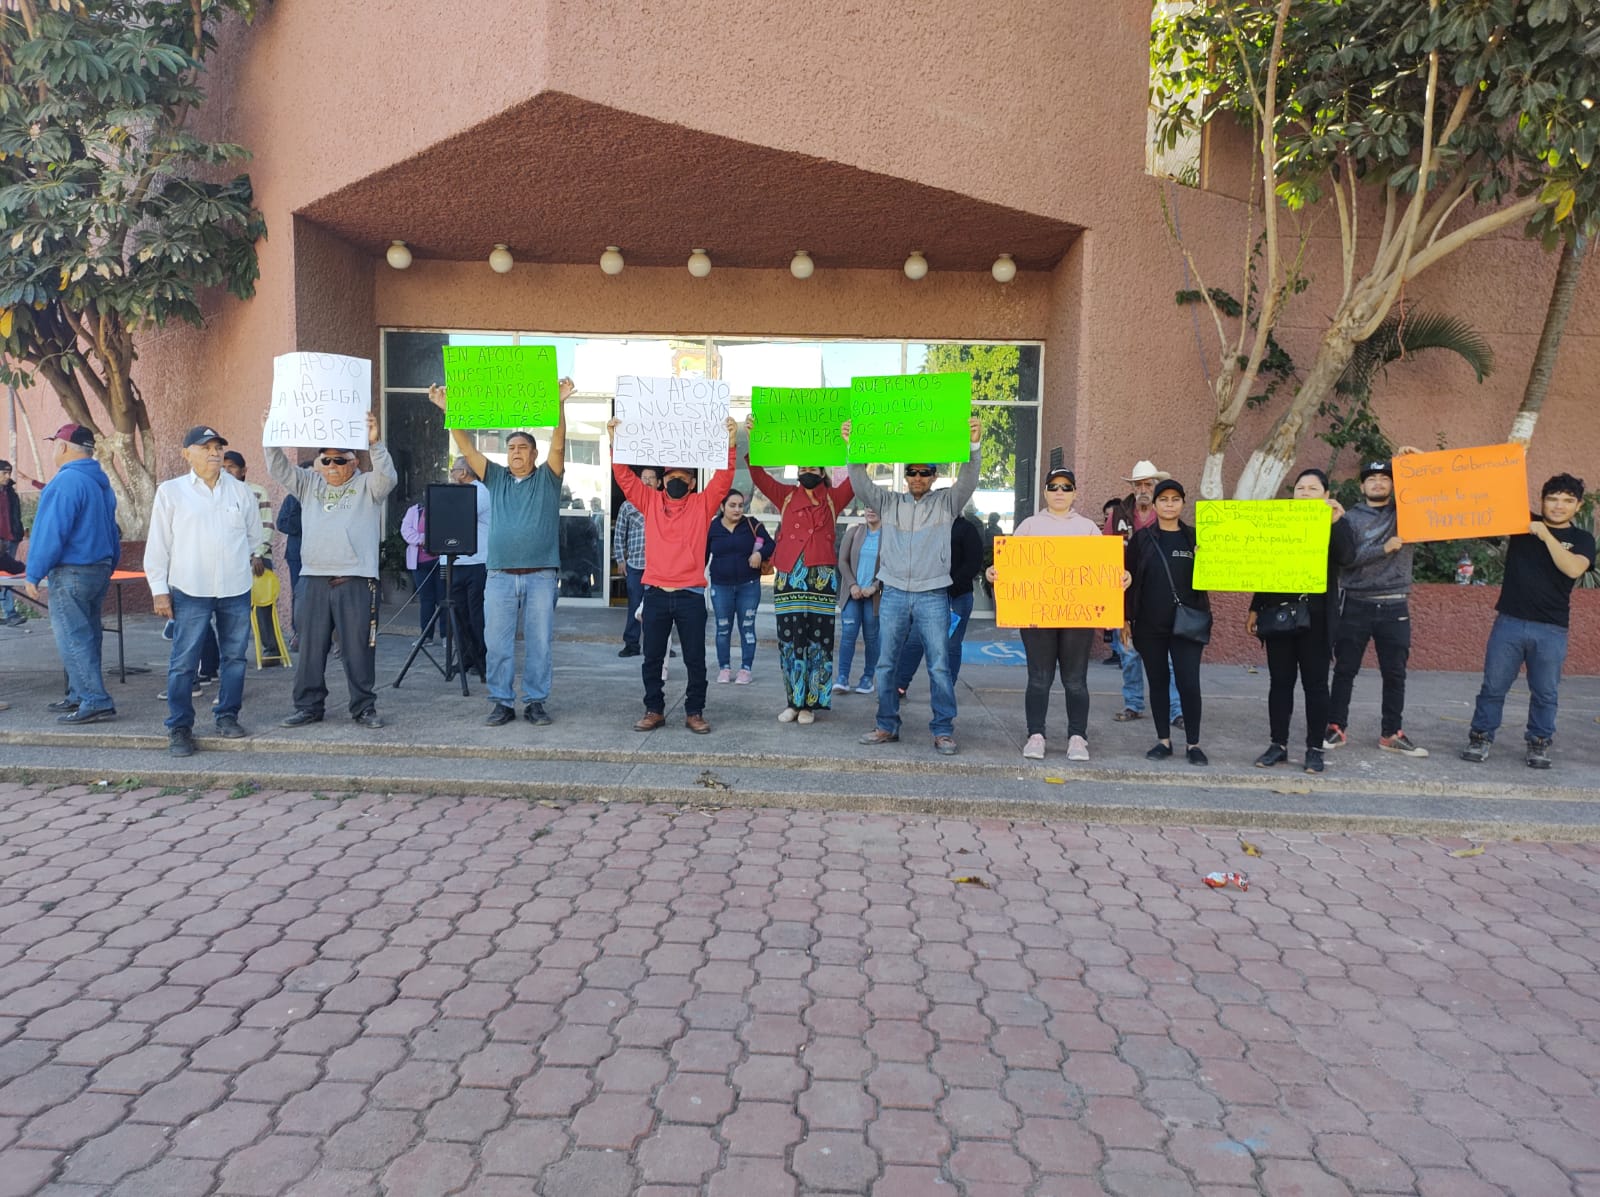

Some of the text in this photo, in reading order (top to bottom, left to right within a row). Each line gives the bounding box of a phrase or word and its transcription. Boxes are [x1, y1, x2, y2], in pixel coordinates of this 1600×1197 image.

[300, 351, 362, 378] APOYO
[447, 347, 549, 364] EN APOYO A
[446, 363, 525, 382] NUESTROS
[302, 373, 314, 391] A
[616, 375, 730, 402] EN APOYO
[853, 376, 943, 393] QUEREMOS
[293, 389, 361, 407] HUELGA
[760, 387, 840, 406] EN APOYO
[302, 404, 325, 418] DE
[447, 402, 471, 413] LOS
[480, 401, 504, 412] SIN
[616, 399, 730, 423] A NUESTROS
[851, 397, 934, 417] SOLUCIÓN
[447, 413, 544, 427] PRESENTES
[767, 411, 787, 426] LA
[270, 419, 362, 443] HAMBRE
[616, 420, 729, 440] COMPAÑEROS
[752, 427, 842, 447] DE HAMBRE
[885, 422, 904, 436] DE
[915, 420, 945, 434] SIN
[616, 438, 728, 452] LOS SIN CASA
[848, 440, 888, 456] CASA
[636, 449, 726, 465] PRESENTES
[1399, 454, 1520, 479] Señor Gobernador
[1223, 501, 1238, 510] La
[1199, 526, 1241, 544] Cumple
[1244, 535, 1256, 545] ya
[1256, 531, 1269, 543] tu
[1043, 563, 1123, 588] GOBERNADO
[1052, 586, 1078, 602] SUS
[1031, 602, 1092, 623] PROMESAS
